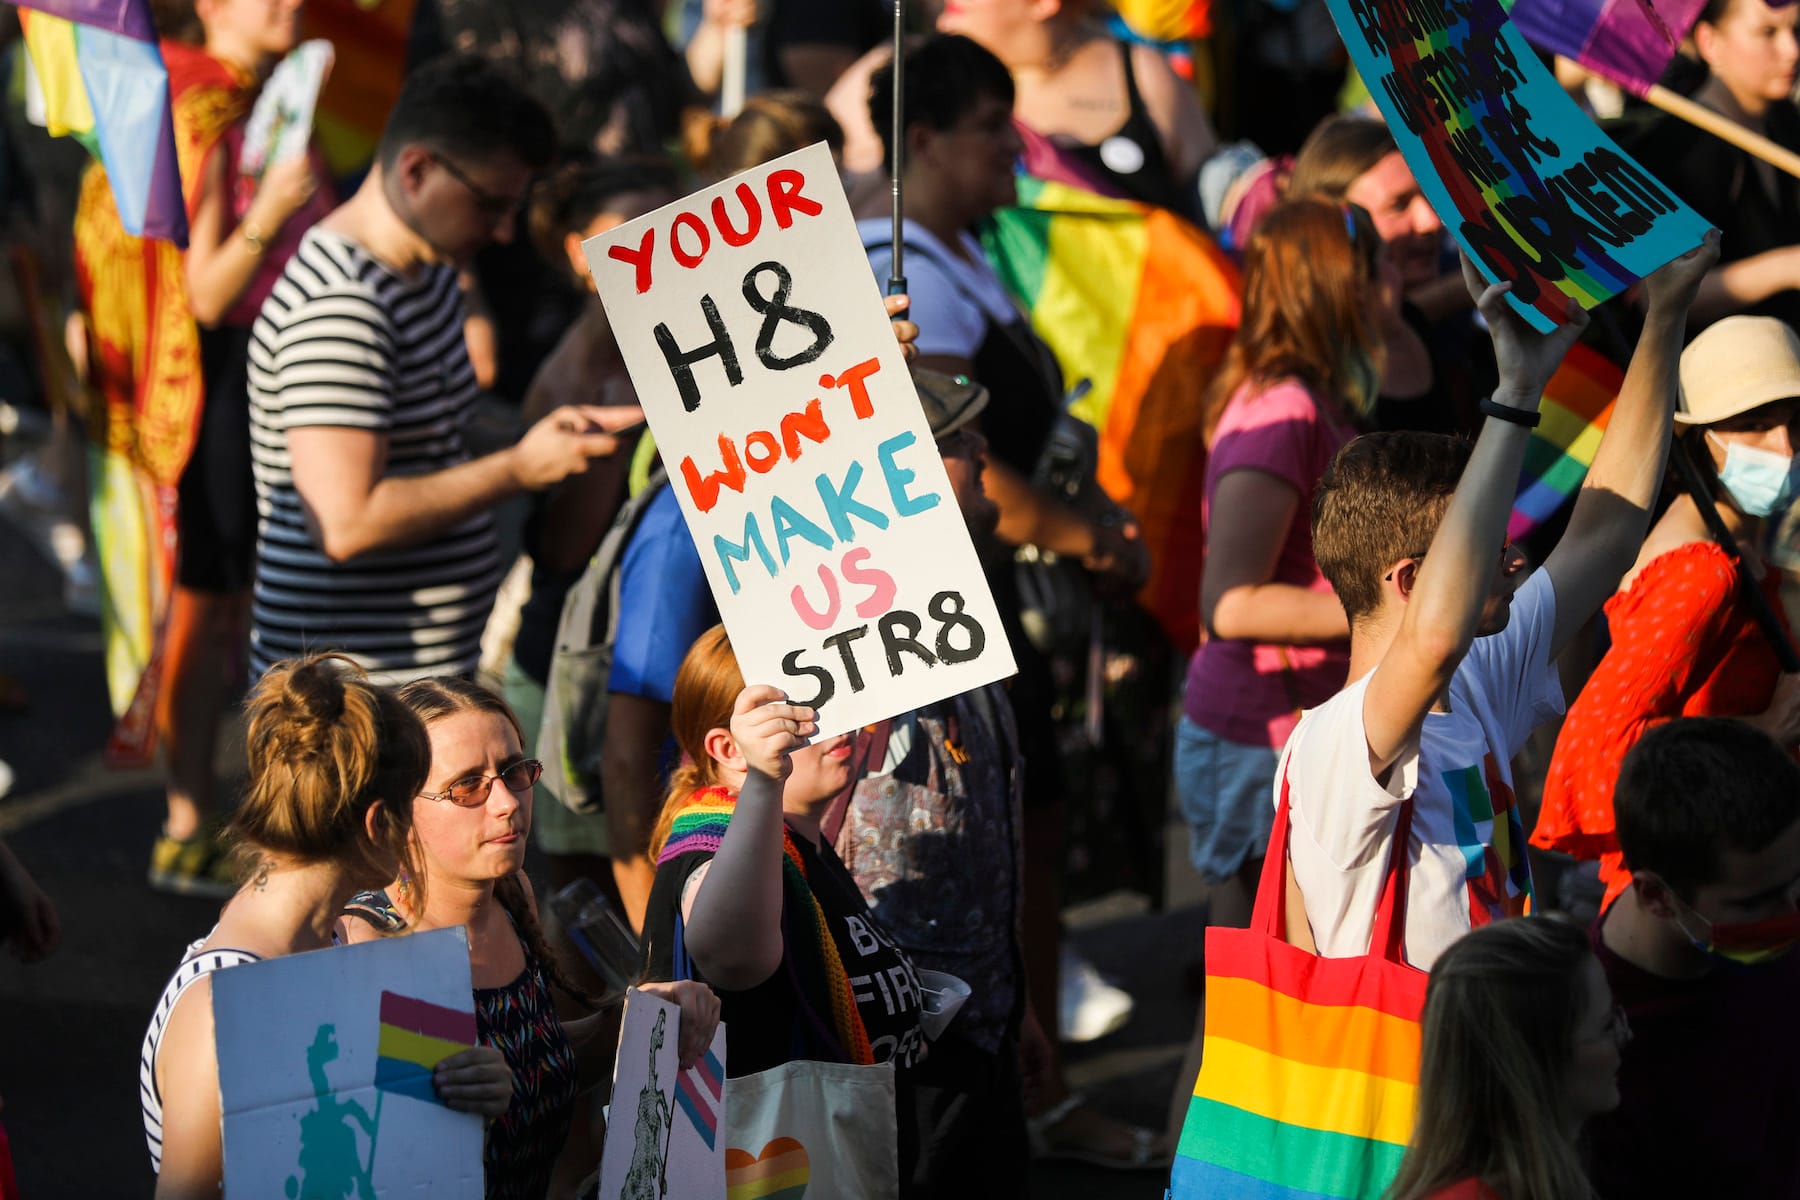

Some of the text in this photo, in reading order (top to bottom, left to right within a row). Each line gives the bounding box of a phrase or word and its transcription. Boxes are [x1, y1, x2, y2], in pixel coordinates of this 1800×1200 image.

[1444, 124, 1509, 193] NIE
[1460, 147, 1679, 304] DUPKIEM
[608, 169, 823, 295] YOUR
[653, 260, 834, 412] H8
[680, 356, 880, 514] WON'T
[713, 430, 941, 595] MAKE
[781, 590, 986, 710] STR8
[790, 546, 897, 630] US
